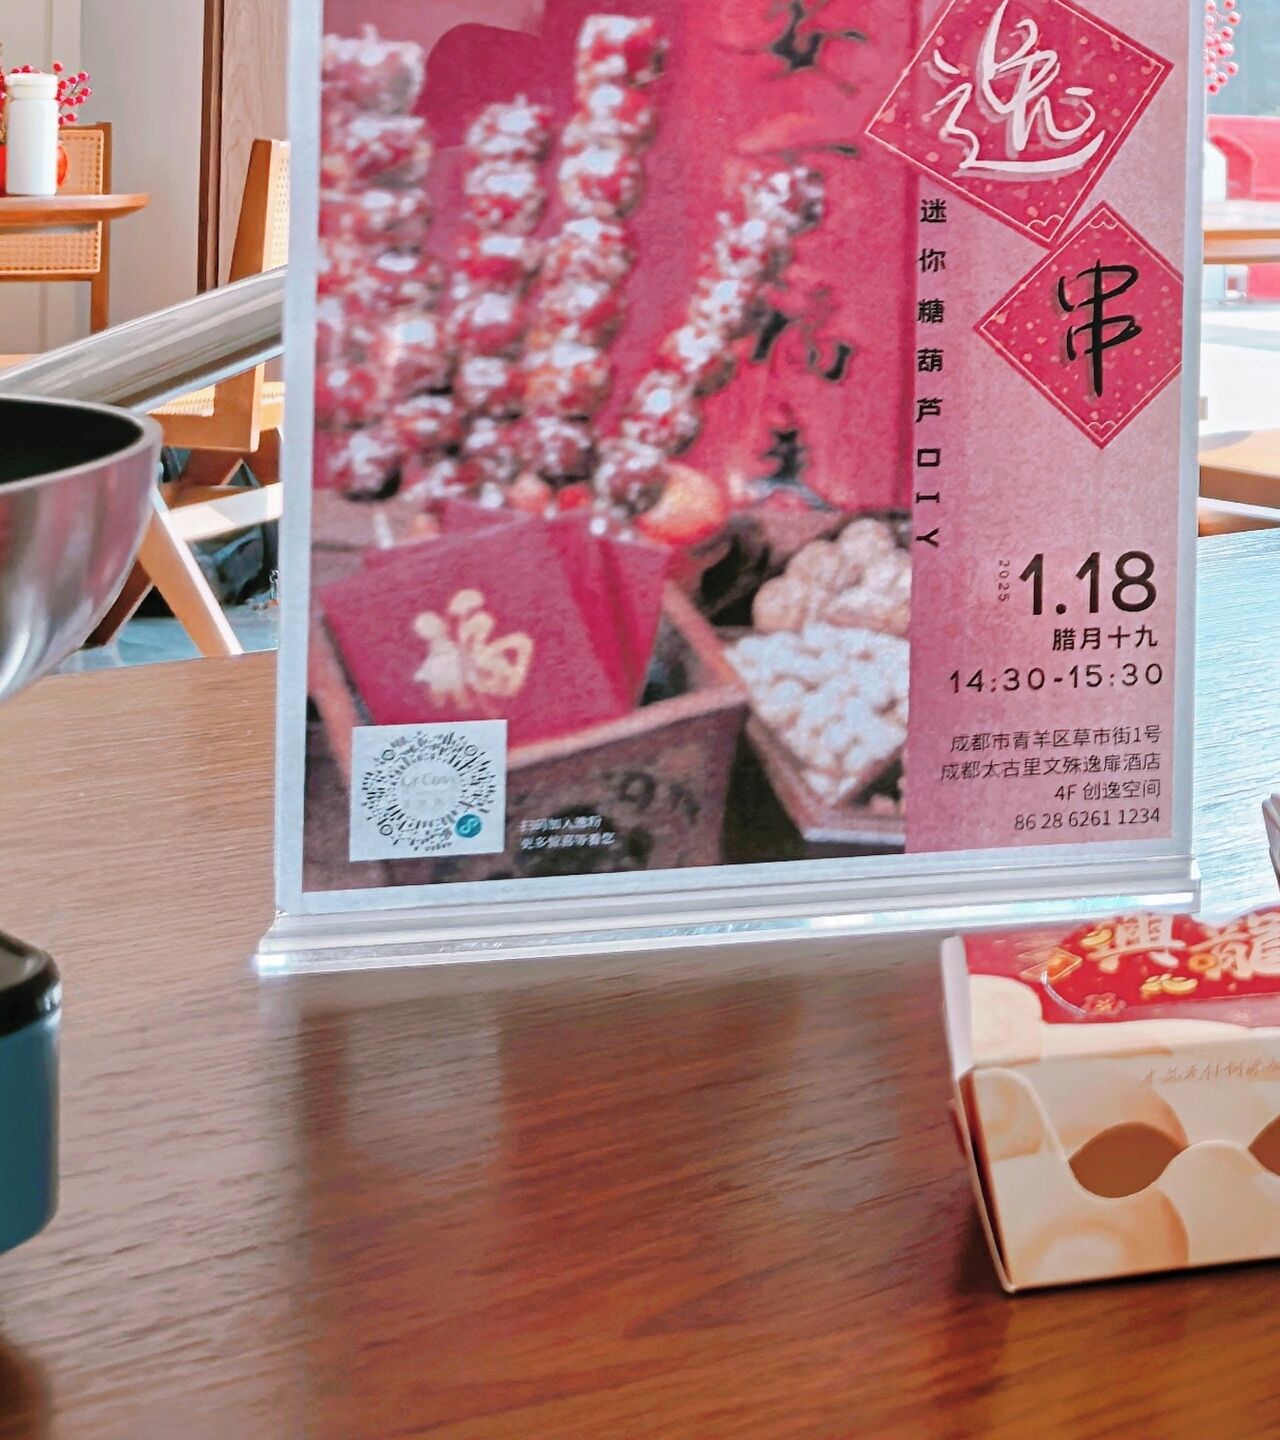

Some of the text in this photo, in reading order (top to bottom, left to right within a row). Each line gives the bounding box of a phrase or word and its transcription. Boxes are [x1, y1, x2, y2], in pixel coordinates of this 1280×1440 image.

[1019, 550, 1157, 616] 1.18
[1052, 624, 1158, 651] 腊月十九
[949, 663, 1163, 694] 14:30-15:30
[950, 724, 1162, 753] 成都市青羊区草市街1号
[1054, 779, 1161, 802] 4F 创逸空间
[1014, 806, 1160, 831] 86 28 6261 1234
